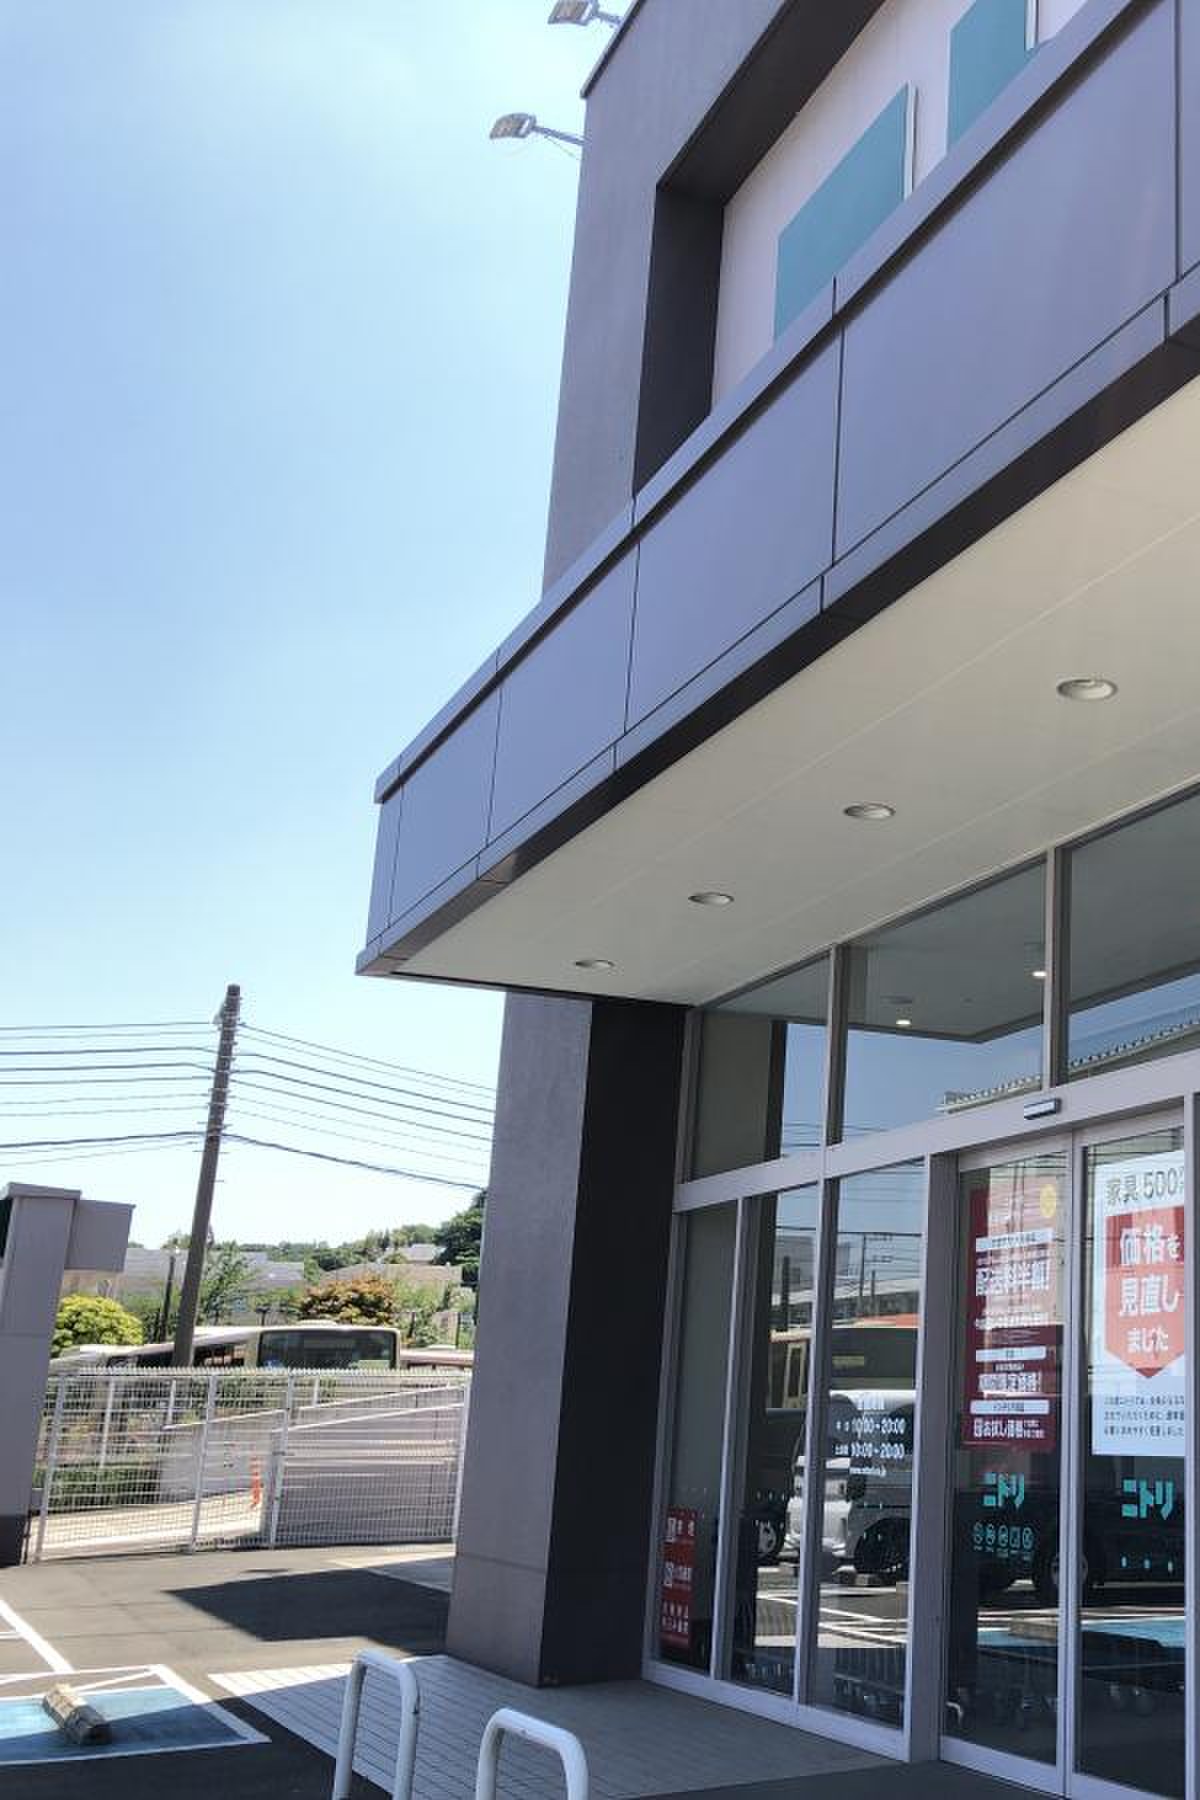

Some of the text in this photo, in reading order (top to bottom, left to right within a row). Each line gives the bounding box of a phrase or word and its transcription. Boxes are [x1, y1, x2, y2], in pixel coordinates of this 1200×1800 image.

[1119, 1225, 1181, 1266] 価格を
[1118, 1273, 1181, 1317] 見直し
[1127, 1327, 1169, 1352] ました
[982, 1472, 1025, 1509] ニトリ
[1121, 1478, 1175, 1520] ニトリ
